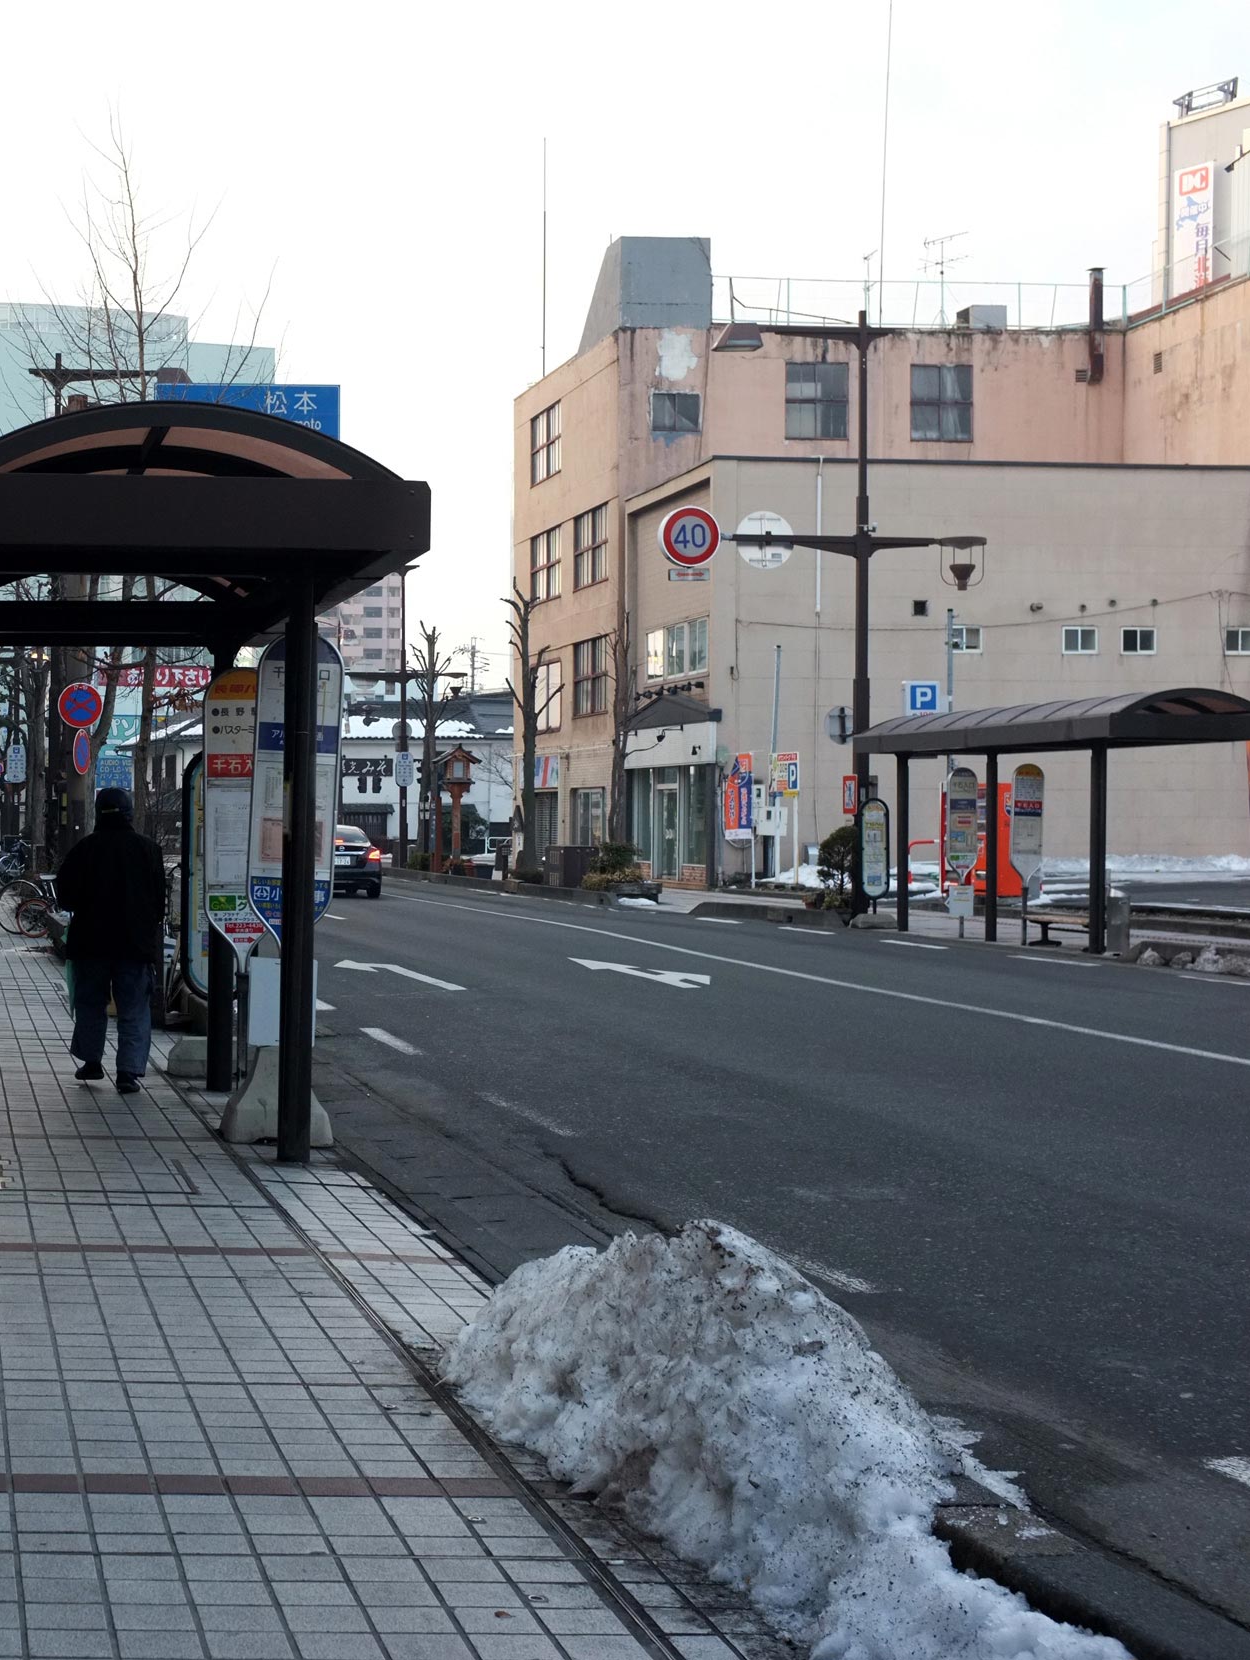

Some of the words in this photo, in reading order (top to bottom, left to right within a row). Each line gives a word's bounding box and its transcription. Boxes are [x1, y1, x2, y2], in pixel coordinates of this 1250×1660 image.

[265, 391, 318, 414] 松本
[673, 523, 707, 549] 40
[916, 687, 932, 708] P
